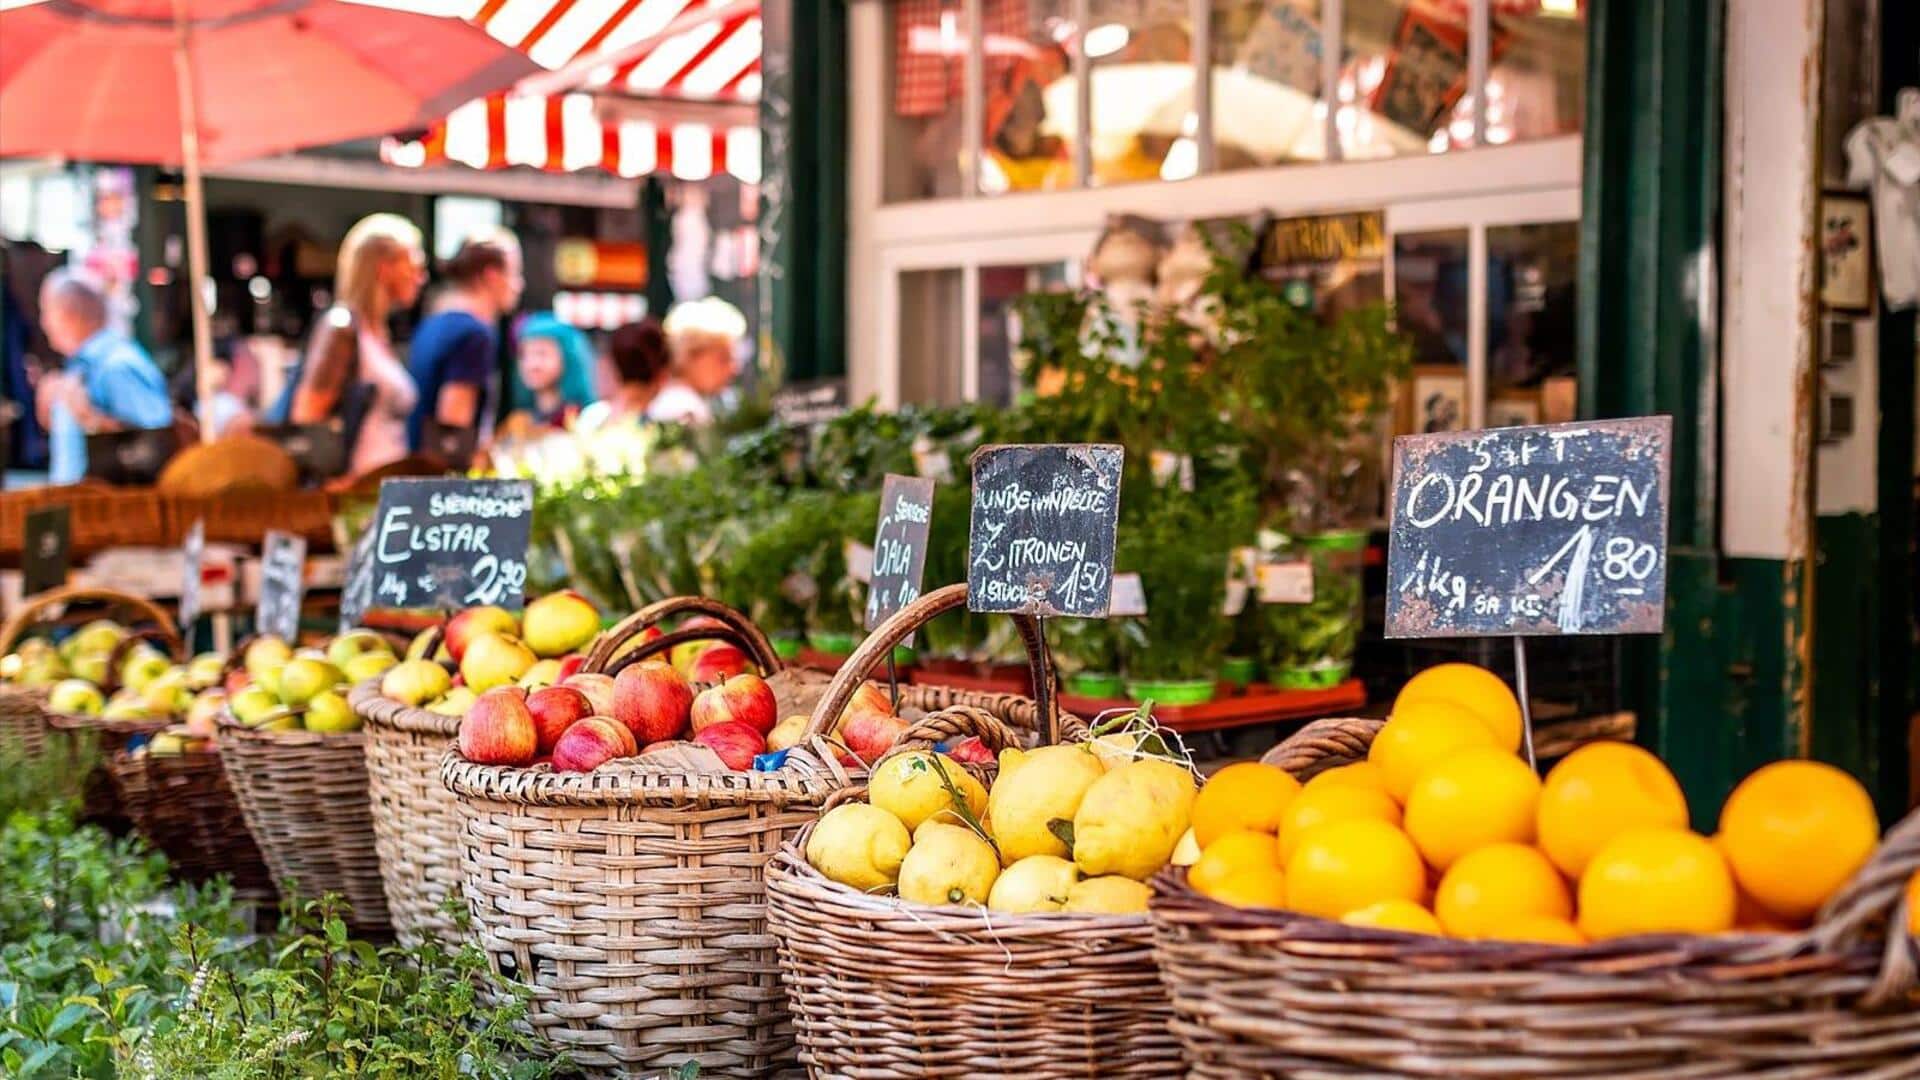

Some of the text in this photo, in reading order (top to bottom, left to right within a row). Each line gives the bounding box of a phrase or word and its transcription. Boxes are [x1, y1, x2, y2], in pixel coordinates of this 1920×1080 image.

[1407, 473, 1650, 528] ORANGEN
[378, 506, 490, 563] ELSTAR
[873, 516, 911, 577] GALA
[973, 518, 1086, 571] ZITRONEN
[1400, 550, 1466, 608] 1kg
